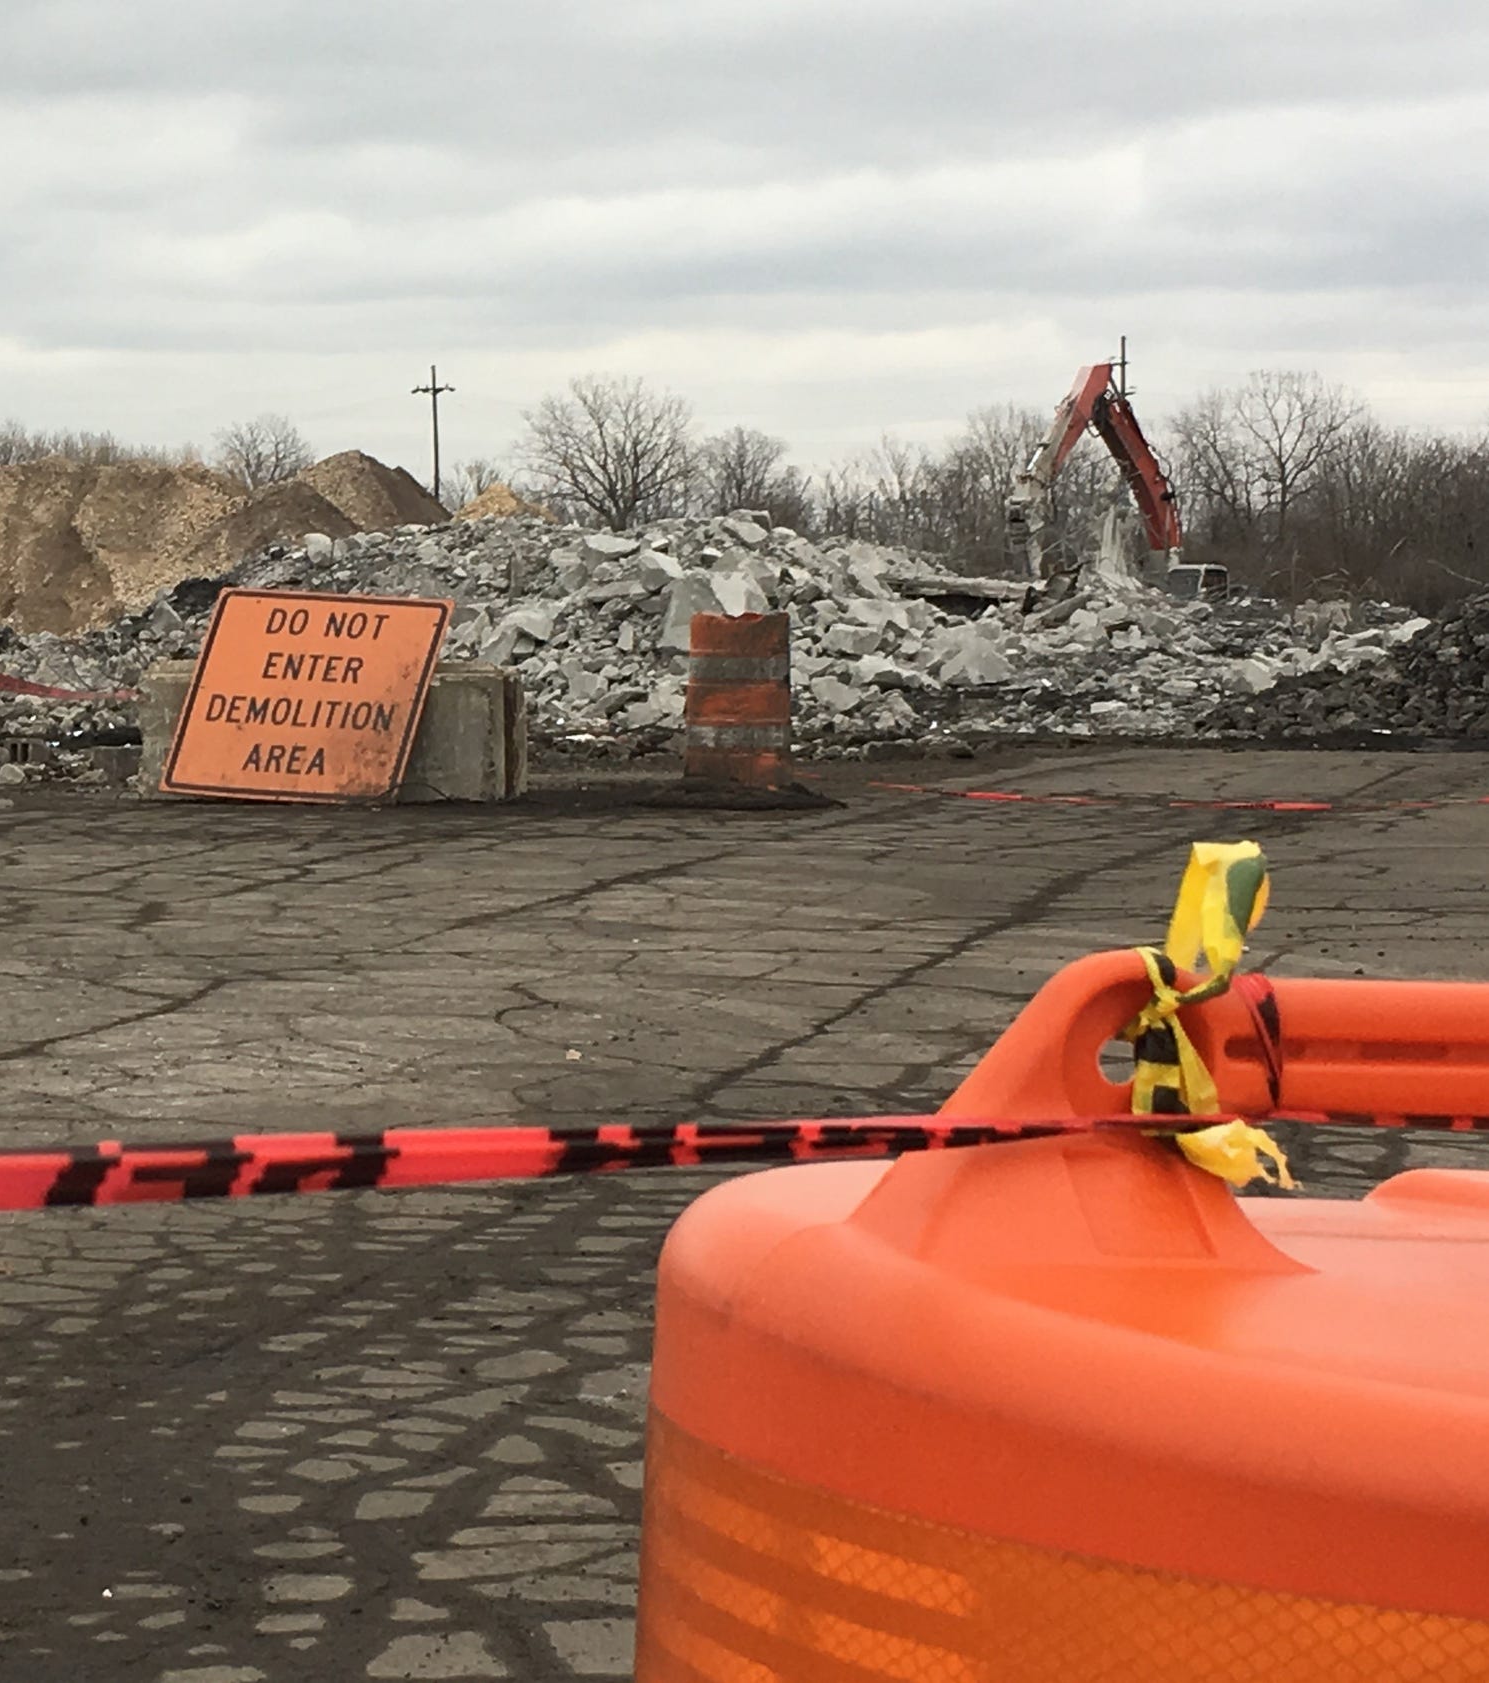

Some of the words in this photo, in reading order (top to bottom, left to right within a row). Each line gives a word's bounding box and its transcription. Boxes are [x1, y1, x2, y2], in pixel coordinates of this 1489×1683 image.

[266, 608, 310, 636] DO
[323, 612, 390, 640] NOT
[262, 653, 364, 683] ENTER
[205, 693, 396, 731] DEMOLITION
[241, 743, 326, 776] AREA
